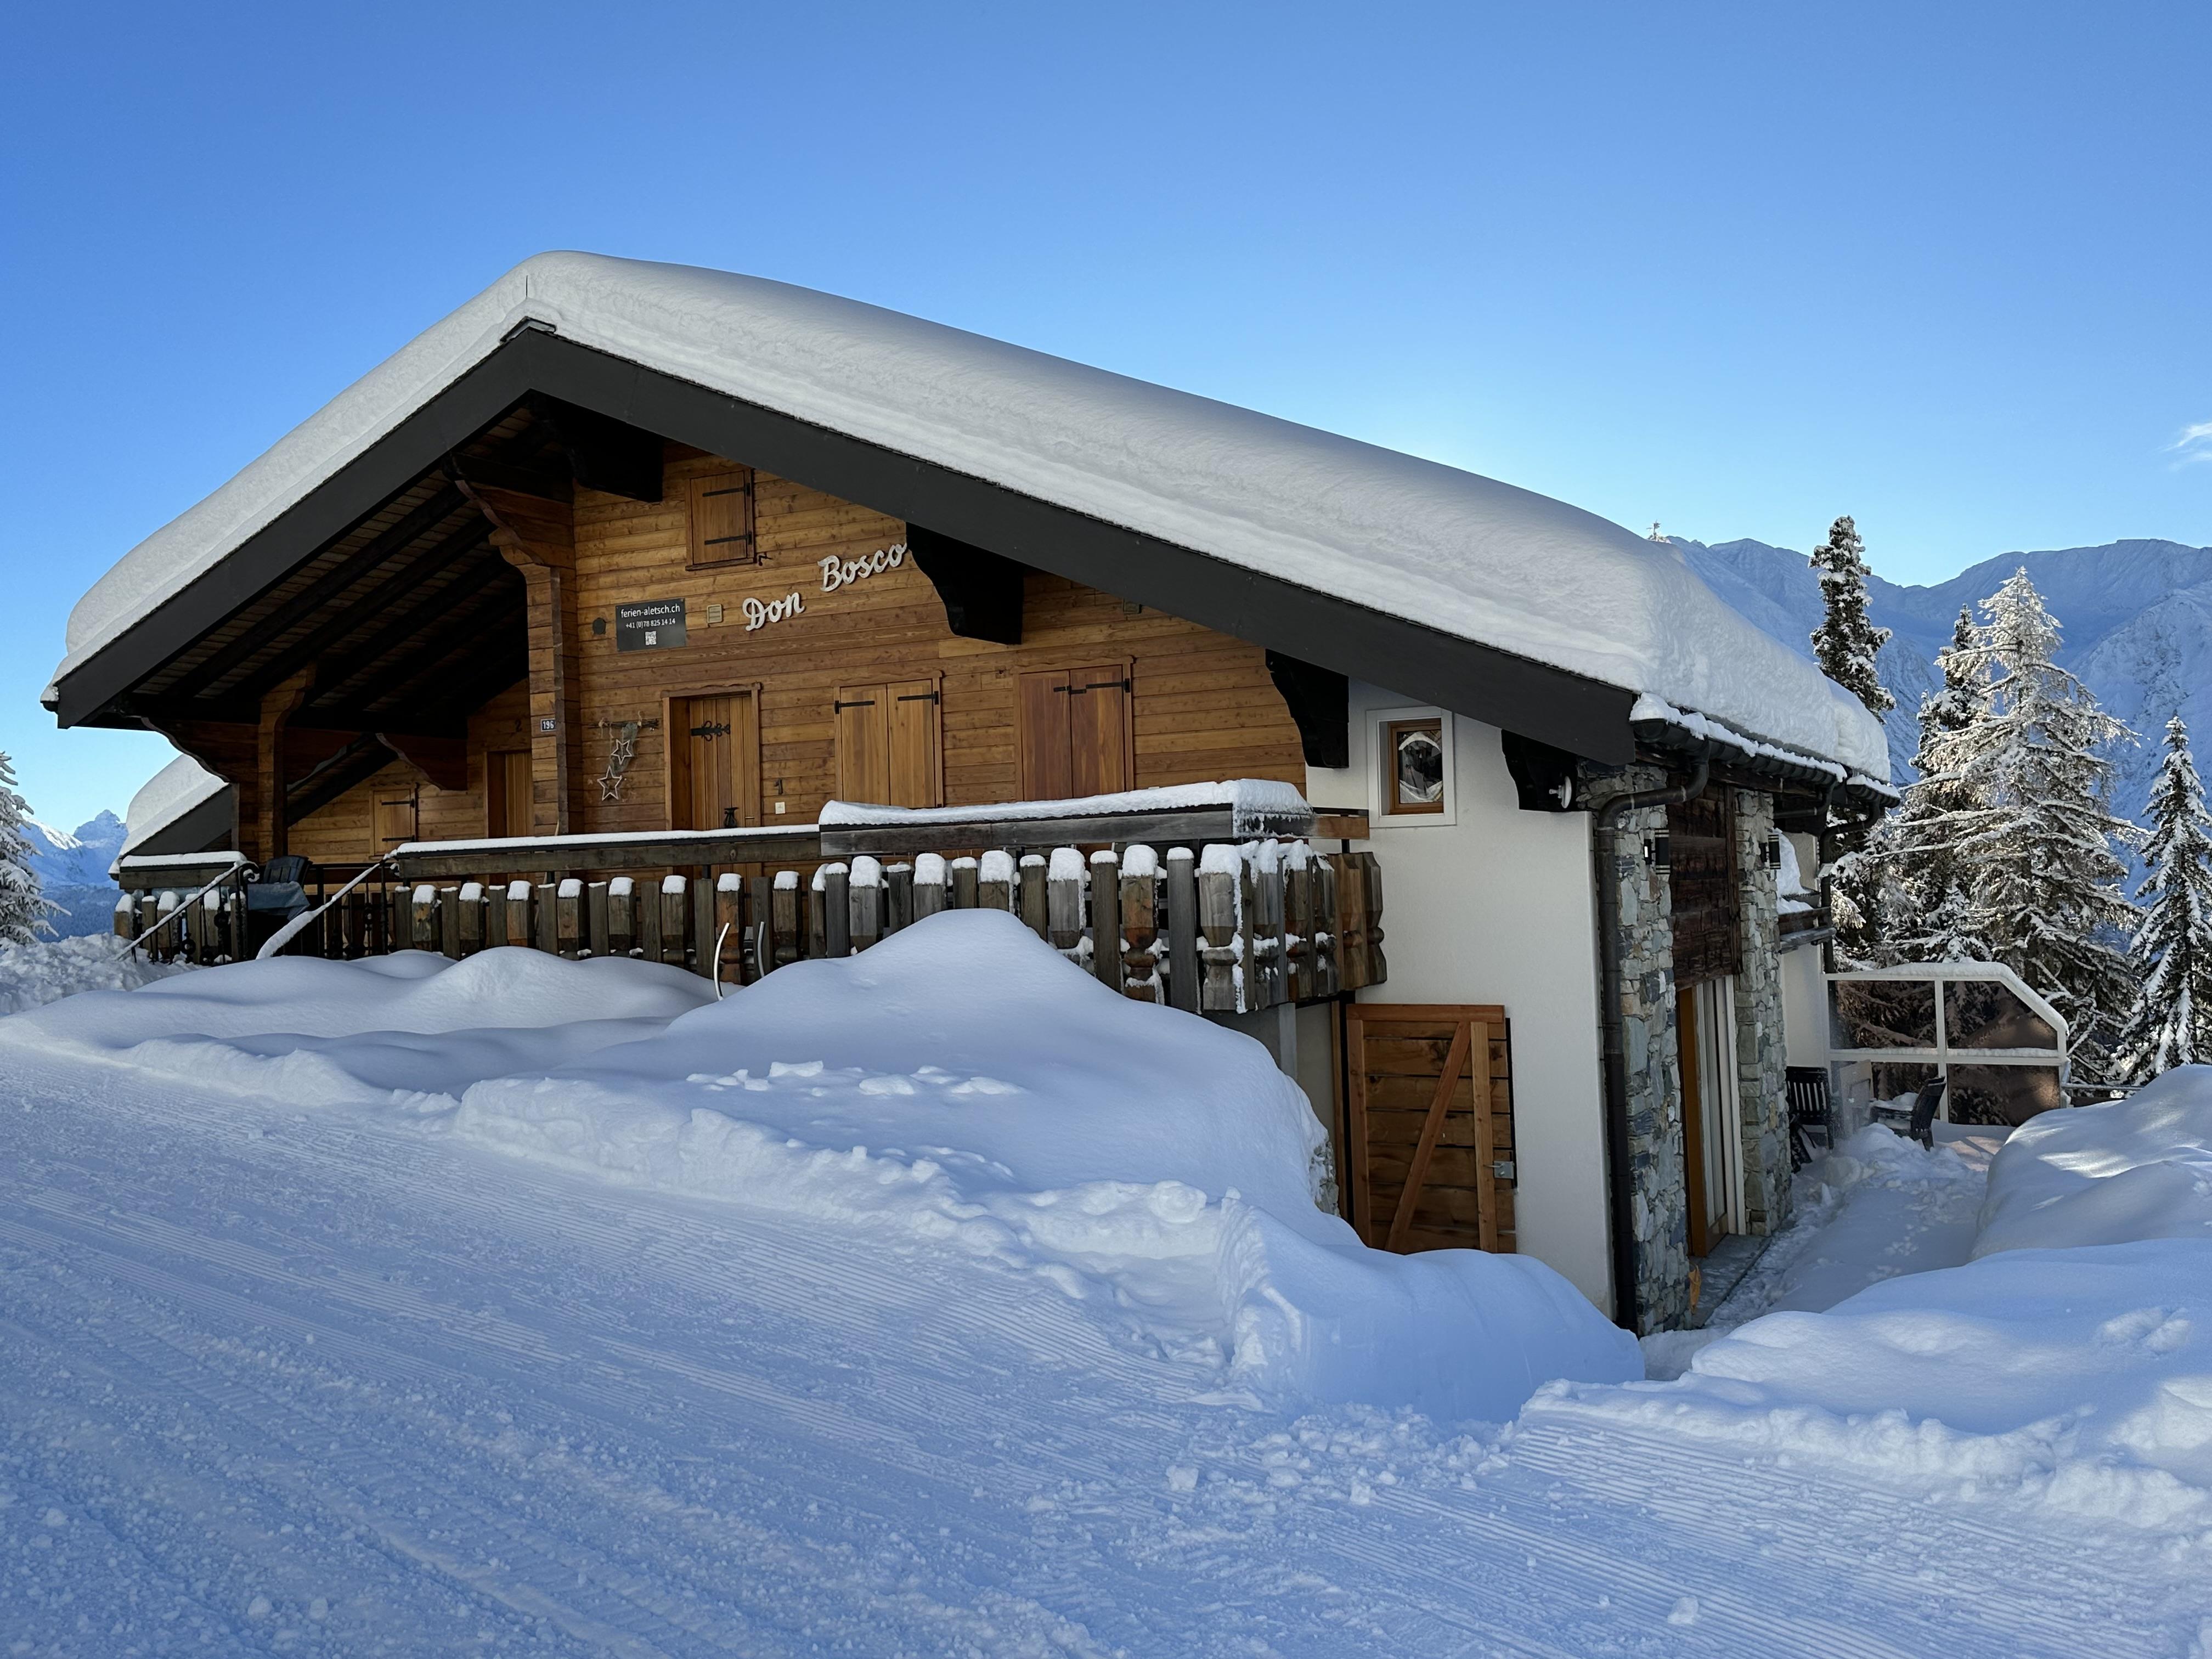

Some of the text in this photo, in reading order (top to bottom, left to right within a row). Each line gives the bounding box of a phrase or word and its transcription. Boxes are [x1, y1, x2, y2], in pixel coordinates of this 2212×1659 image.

[742, 543, 907, 631] Don Bosco
[620, 603, 680, 618] ferien-aletsch.ch
[543, 720, 554, 730] 196
[774, 779, 783, 794] 1
